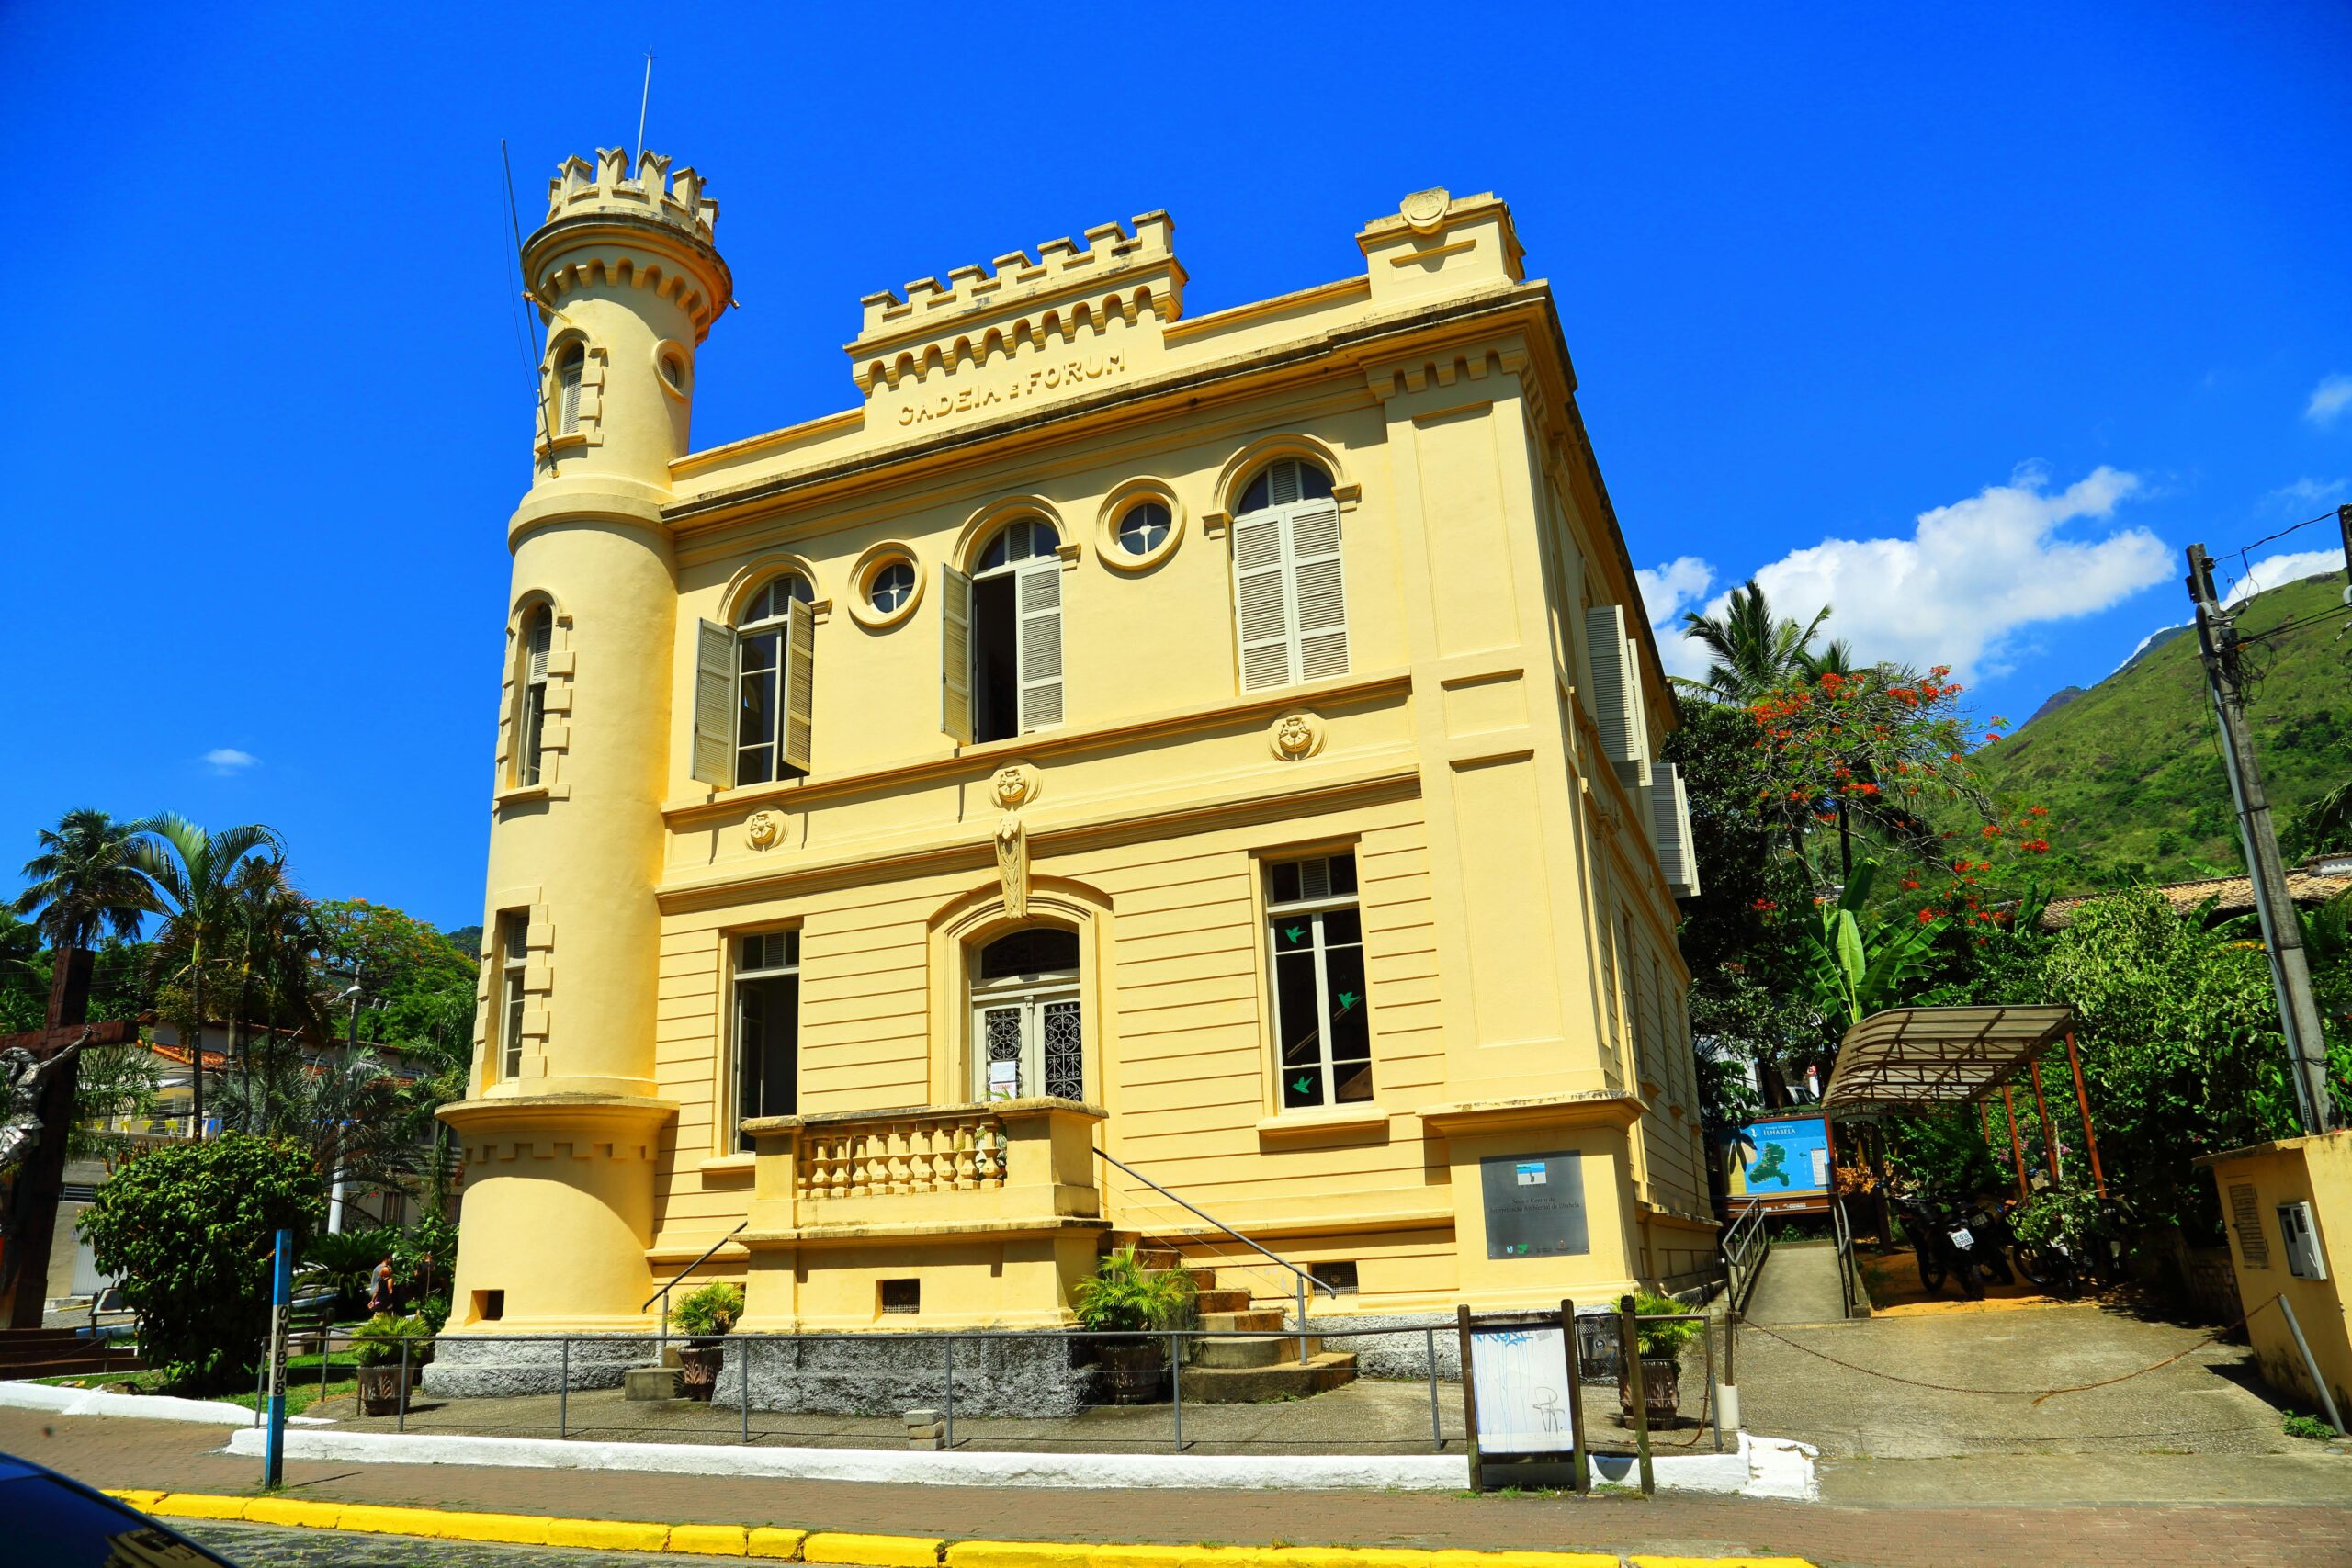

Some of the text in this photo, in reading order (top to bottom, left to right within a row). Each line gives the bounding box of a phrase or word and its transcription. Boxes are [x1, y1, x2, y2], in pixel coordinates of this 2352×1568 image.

[898, 383, 1001, 426] CADEIA
[1025, 346, 1125, 395] FORUM
[1763, 1128, 1796, 1136] ILHABELA
[275, 1305, 288, 1395] ONIBUS
